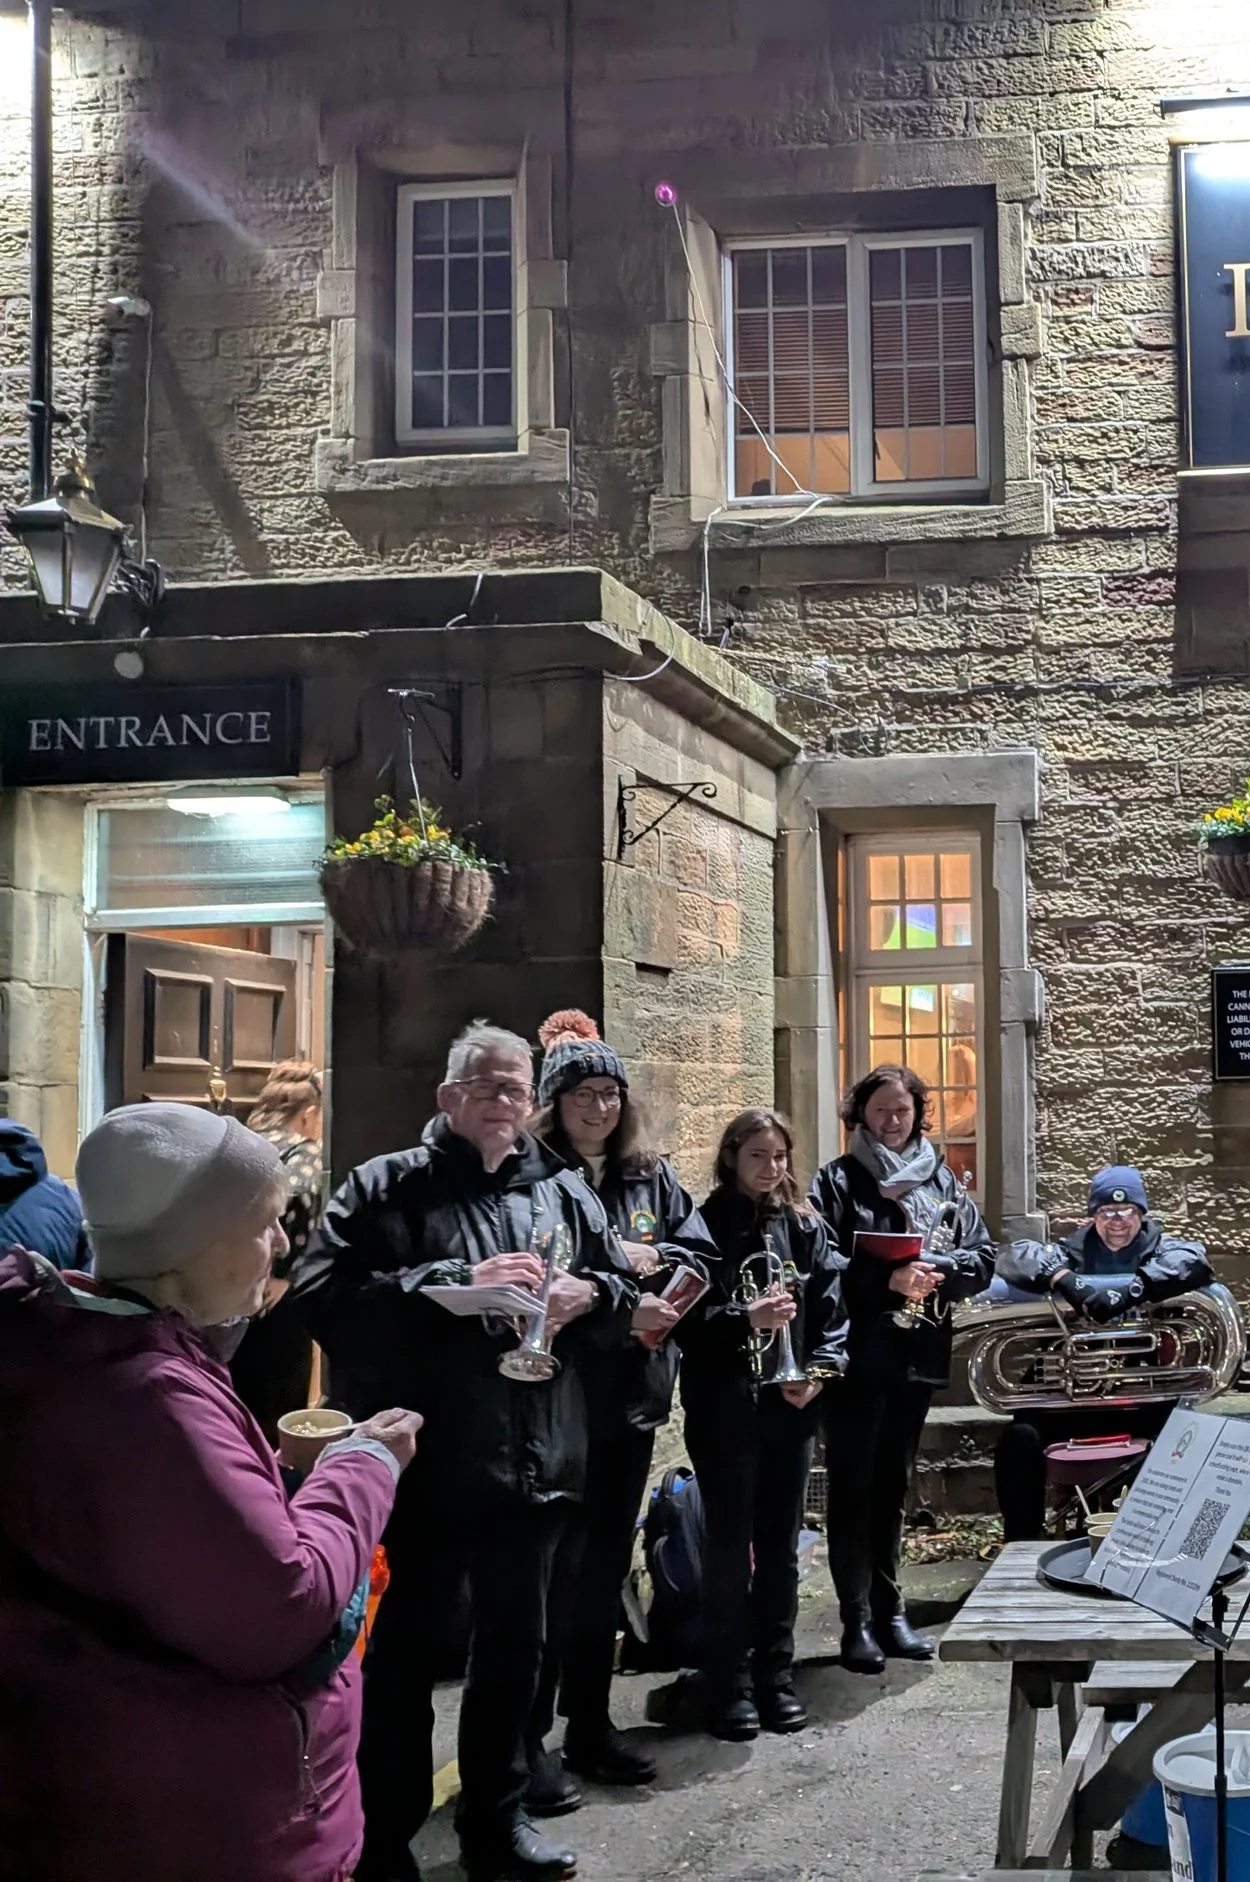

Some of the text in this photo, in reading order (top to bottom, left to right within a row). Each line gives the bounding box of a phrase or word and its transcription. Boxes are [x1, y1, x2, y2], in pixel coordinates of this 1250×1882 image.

[28, 711, 272, 751] ENTRANCE
[1232, 990, 1247, 998] THE
[1230, 1027, 1242, 1036] OR
